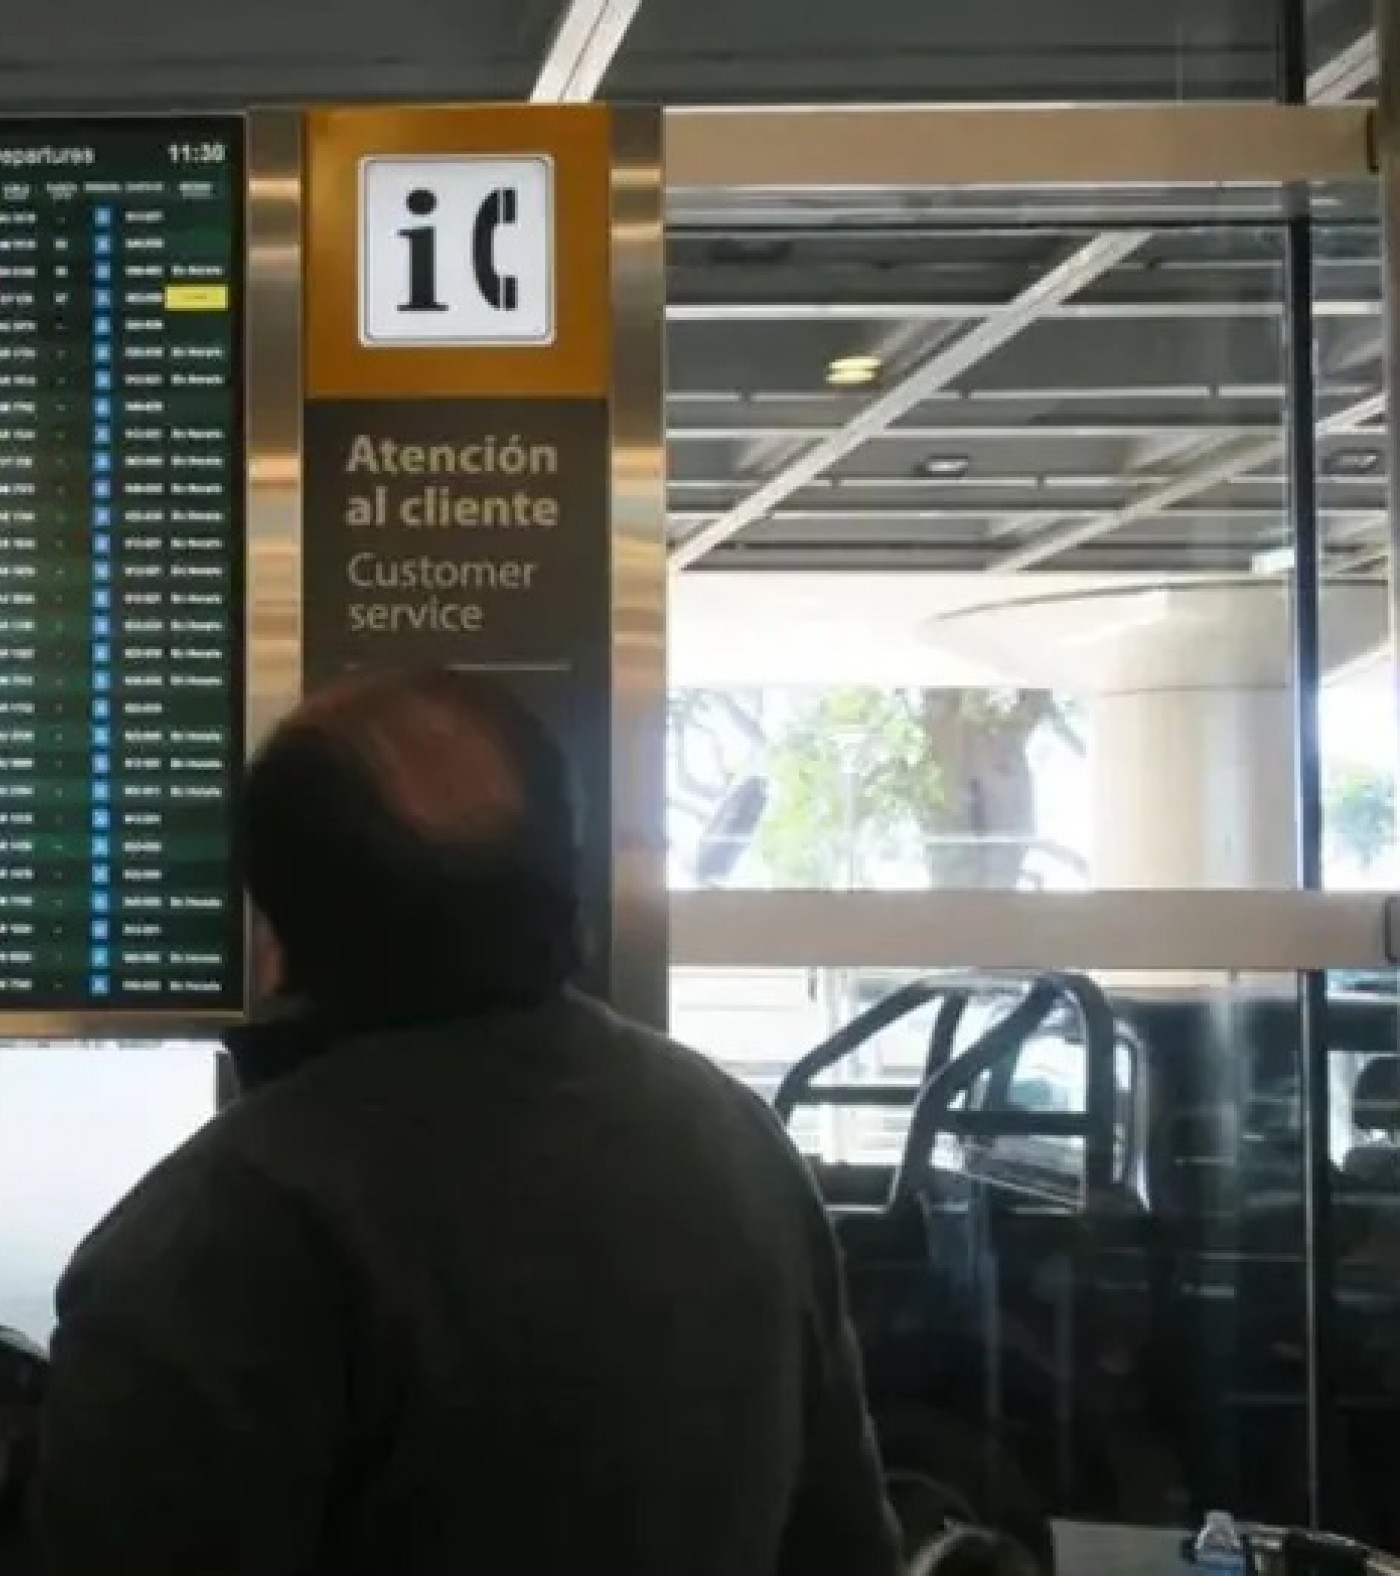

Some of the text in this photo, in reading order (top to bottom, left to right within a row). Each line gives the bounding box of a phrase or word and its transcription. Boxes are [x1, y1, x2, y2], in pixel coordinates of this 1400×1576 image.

[168, 143, 227, 164] 11:30
[345, 434, 558, 474] Atención
[346, 486, 559, 527] al cliente
[348, 551, 538, 588] Customer
[350, 595, 484, 631] service
